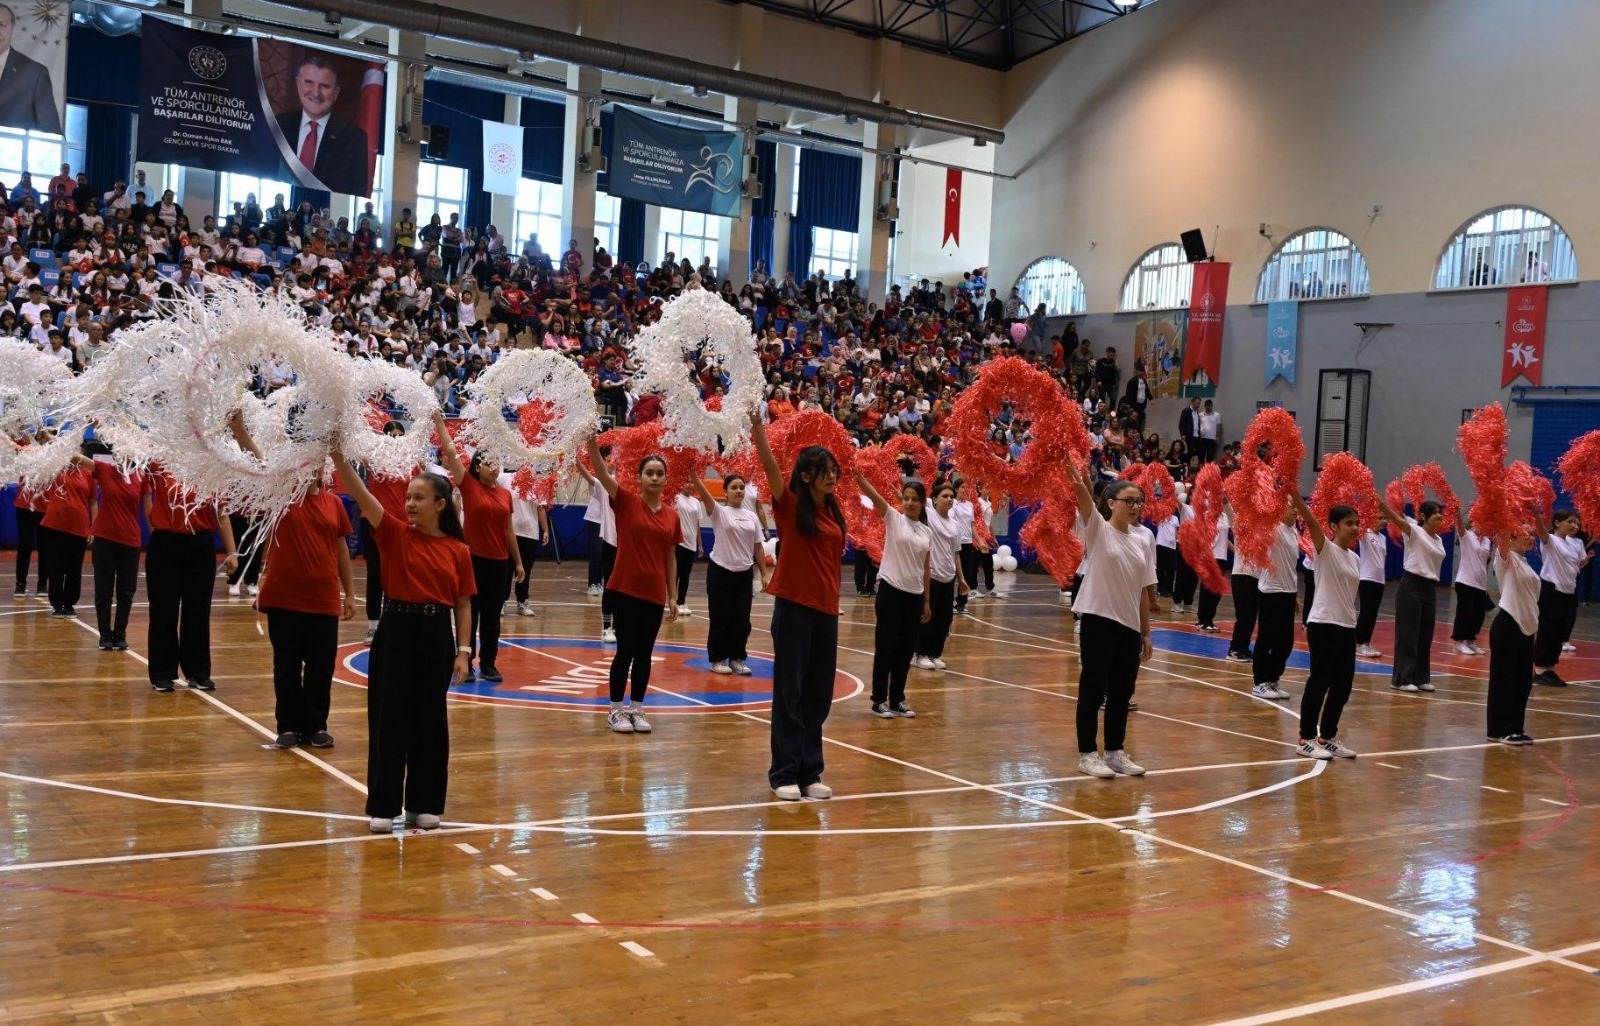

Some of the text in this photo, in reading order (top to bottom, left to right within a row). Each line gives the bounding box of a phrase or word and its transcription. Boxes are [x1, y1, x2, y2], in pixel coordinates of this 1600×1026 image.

[151, 96, 255, 122] VE SPORCULARIMIZA
[164, 86, 245, 109] TÜM ANTRENÖR
[153, 108, 251, 131] BAŞARILAR DİLİYORUM
